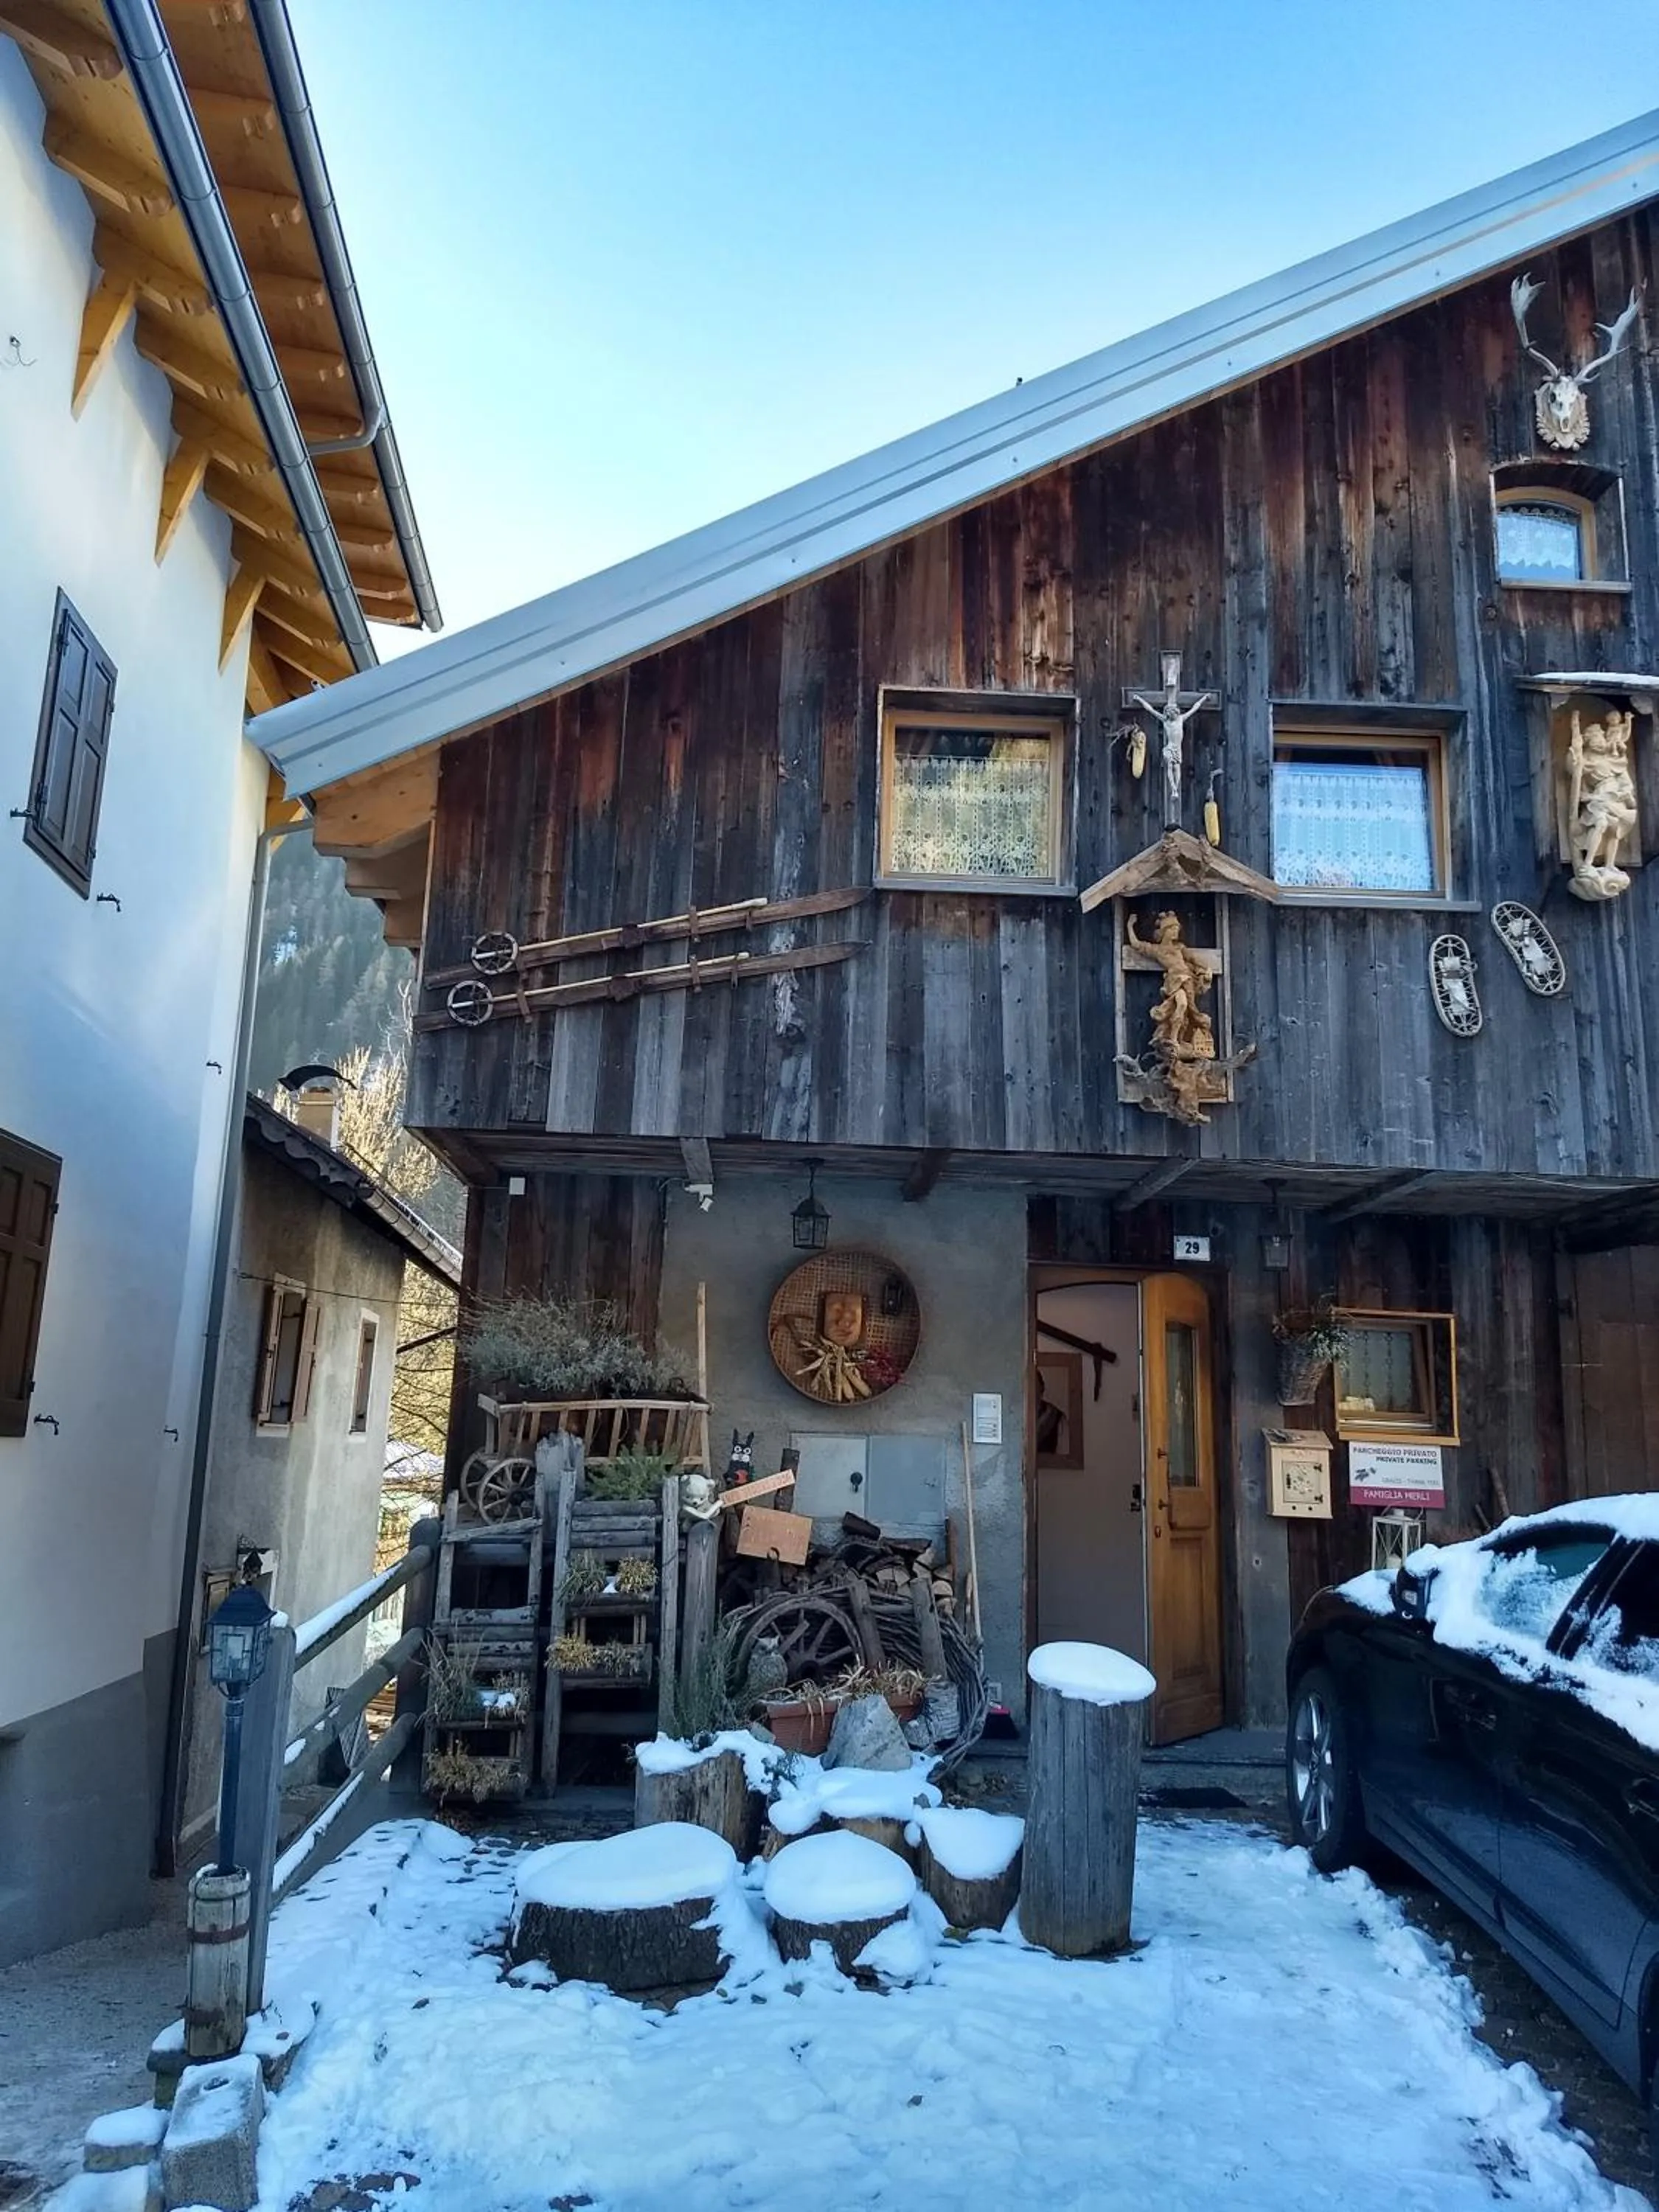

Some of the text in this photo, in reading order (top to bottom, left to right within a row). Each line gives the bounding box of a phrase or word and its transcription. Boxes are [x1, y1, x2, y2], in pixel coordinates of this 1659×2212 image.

[1185, 1242, 1200, 1254] 29
[1403, 1450, 1437, 1458] PRIVATO
[1363, 1489, 1402, 1499] FAMIGLIA
